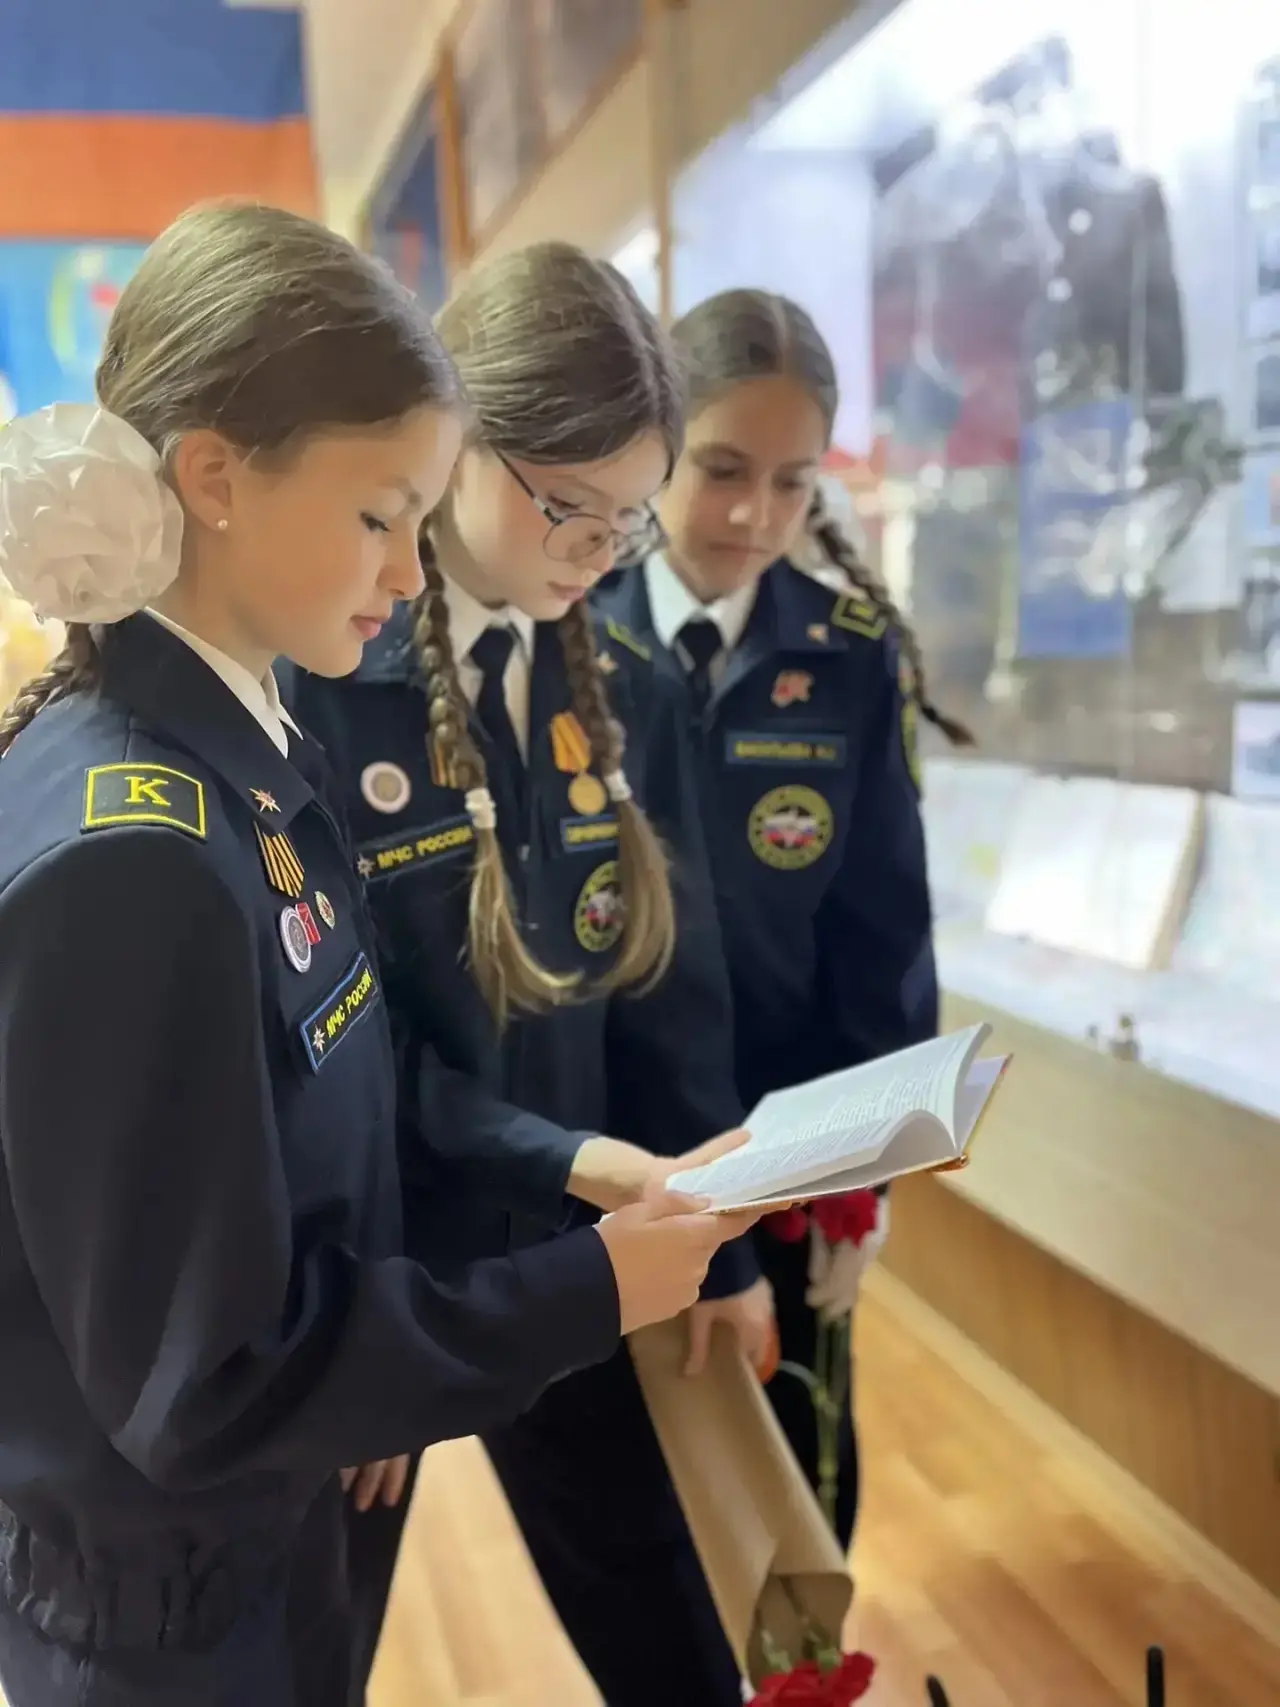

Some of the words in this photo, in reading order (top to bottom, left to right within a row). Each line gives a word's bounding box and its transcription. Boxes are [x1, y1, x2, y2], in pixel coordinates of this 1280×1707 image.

[124, 776, 171, 806] К
[377, 845, 414, 869] МЧС
[326, 1004, 346, 1038] МЧС
